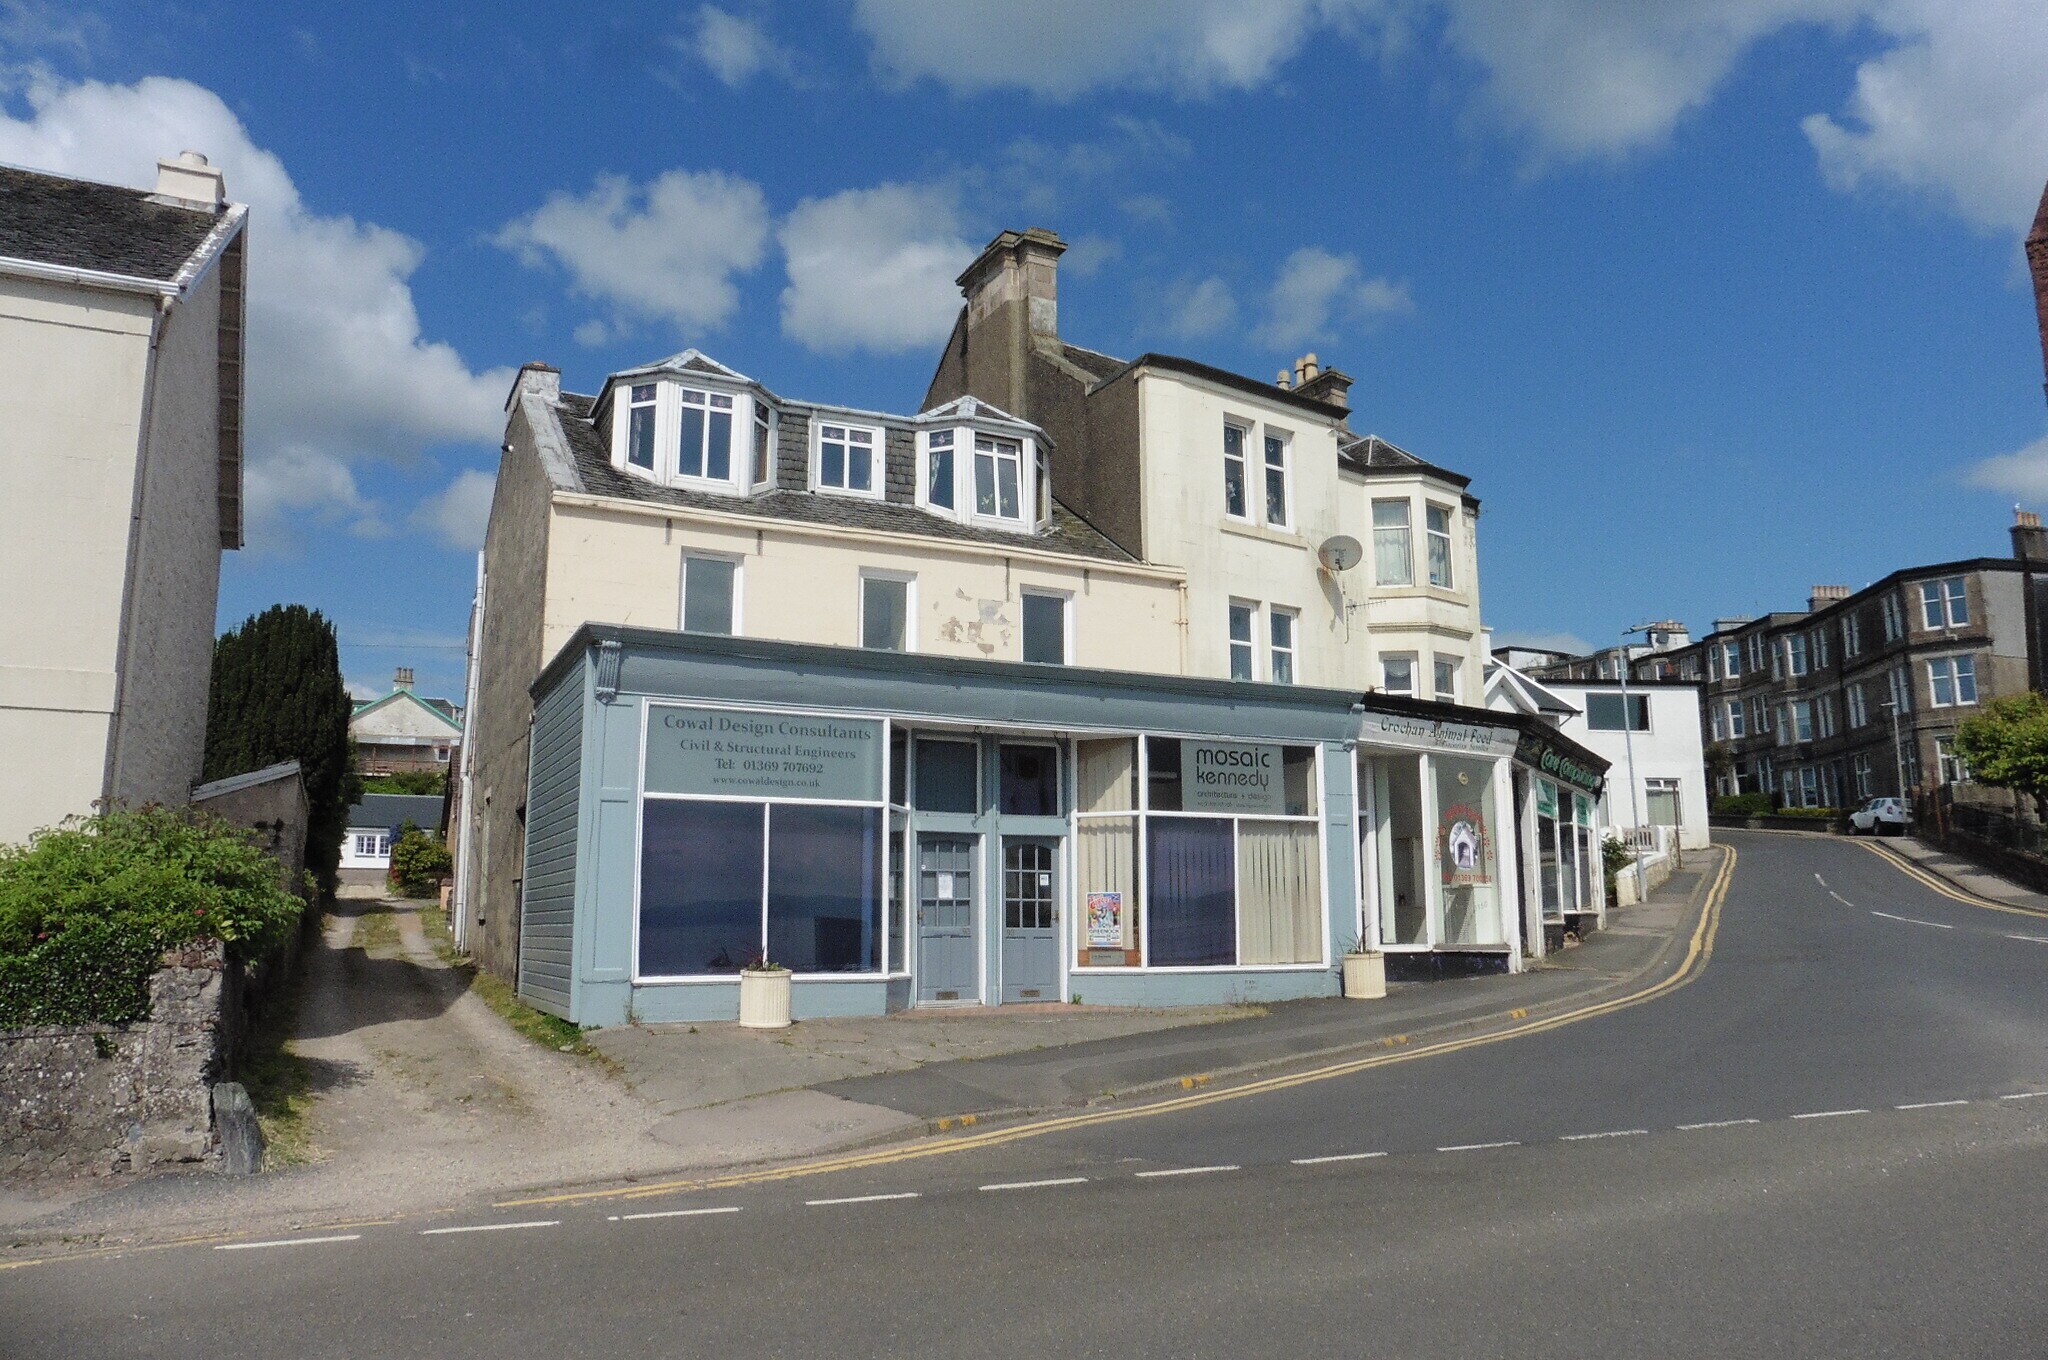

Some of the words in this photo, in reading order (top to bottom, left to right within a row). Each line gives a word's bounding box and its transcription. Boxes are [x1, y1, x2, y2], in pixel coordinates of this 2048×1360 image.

[664, 713, 713, 731] Cowal
[719, 717, 774, 737] Design
[778, 721, 872, 740] Consultants
[1428, 723, 1467, 743] Animal
[1469, 728, 1493, 745] Feed
[680, 739, 710, 751] Civil
[714, 741, 724, 752] &
[726, 741, 791, 755] Structural
[795, 744, 857, 760] Engineers
[1196, 747, 1270, 767] mosaic
[715, 758, 735, 770] Tel:
[743, 760, 778, 772] 01369
[783, 761, 824, 773] 707692
[712, 775, 821, 789] www.cowaldesign.co.uk
[1196, 765, 1270, 791] kennedy
